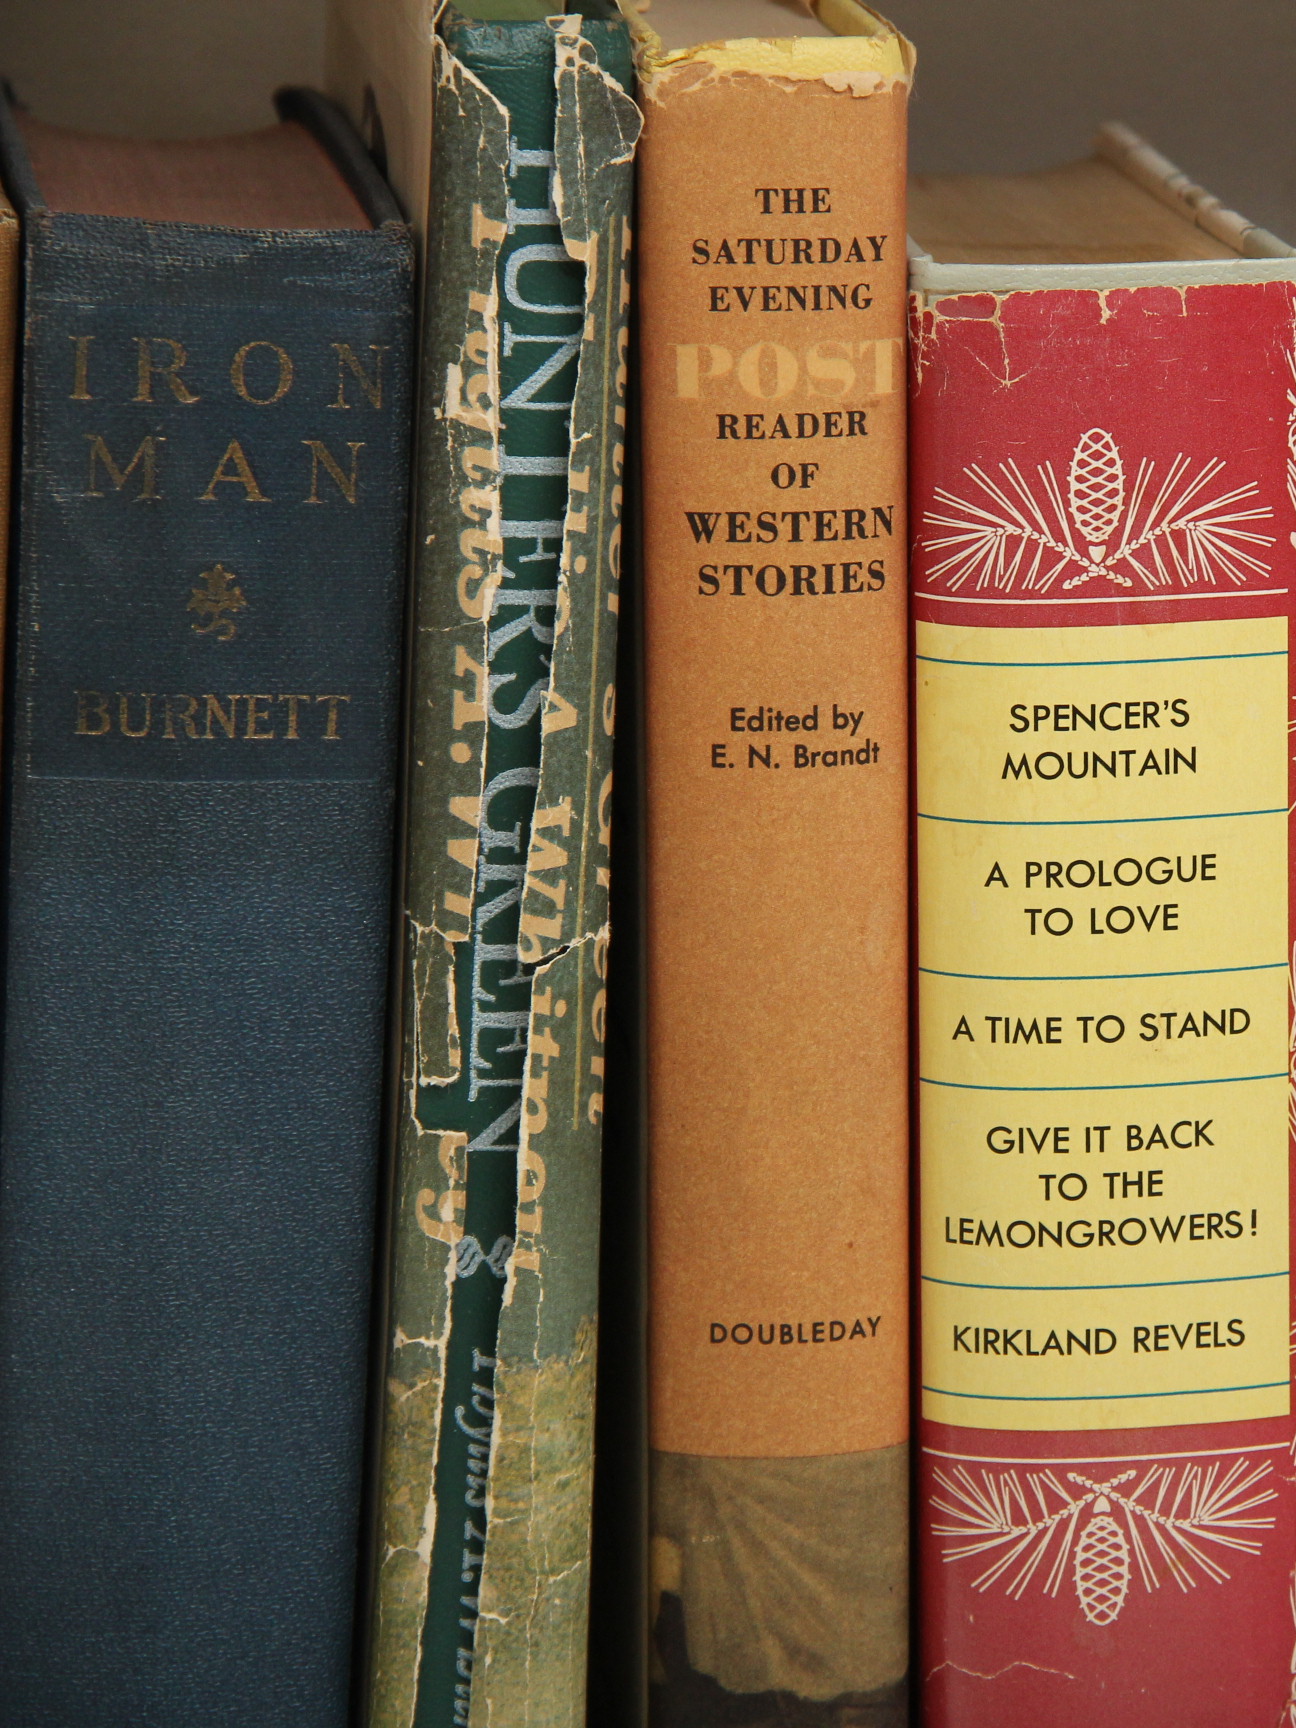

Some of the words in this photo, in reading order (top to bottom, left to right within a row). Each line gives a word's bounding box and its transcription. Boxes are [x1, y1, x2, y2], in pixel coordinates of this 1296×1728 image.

[755, 187, 832, 215] THE
[691, 234, 889, 265] SATURDAY
[708, 283, 873, 313] EVENING
[68, 336, 391, 409] IRON
[674, 337, 905, 400] POST
[716, 410, 868, 441] READER
[84, 434, 366, 504] MAN
[770, 462, 819, 489] OF
[684, 505, 895, 544] WESTERN
[697, 560, 886, 597] STORIES
[73, 690, 351, 741] BURNETT
[729, 705, 818, 733] Edited
[831, 703, 865, 737] by
[1009, 698, 1191, 733] SPENCER'S
[711, 744, 735, 769] E.
[747, 743, 780, 769] N.
[794, 738, 880, 768] Brandt
[1001, 746, 1198, 781] MOUNTAIN
[984, 861, 1010, 889] A
[1024, 853, 1217, 889] PROLOGUE
[1024, 907, 1074, 937] TO
[1090, 903, 1179, 936] LOVE
[952, 1014, 975, 1043] A
[985, 1015, 1062, 1045] TIME
[1077, 1014, 1125, 1044] TO
[1139, 1007, 1252, 1043] STAND
[986, 1125, 1070, 1155] GIVE
[1085, 1125, 1111, 1154] IT
[1126, 1118, 1215, 1152] BACK
[1038, 1172, 1088, 1202] TO
[1103, 1169, 1164, 1200] THE
[945, 1208, 1259, 1249] LEMONGROWERS!
[709, 1315, 882, 1345] DOUBLEDAY
[952, 1324, 1118, 1357] KIRKLAND
[1132, 1318, 1246, 1354] REVELS
